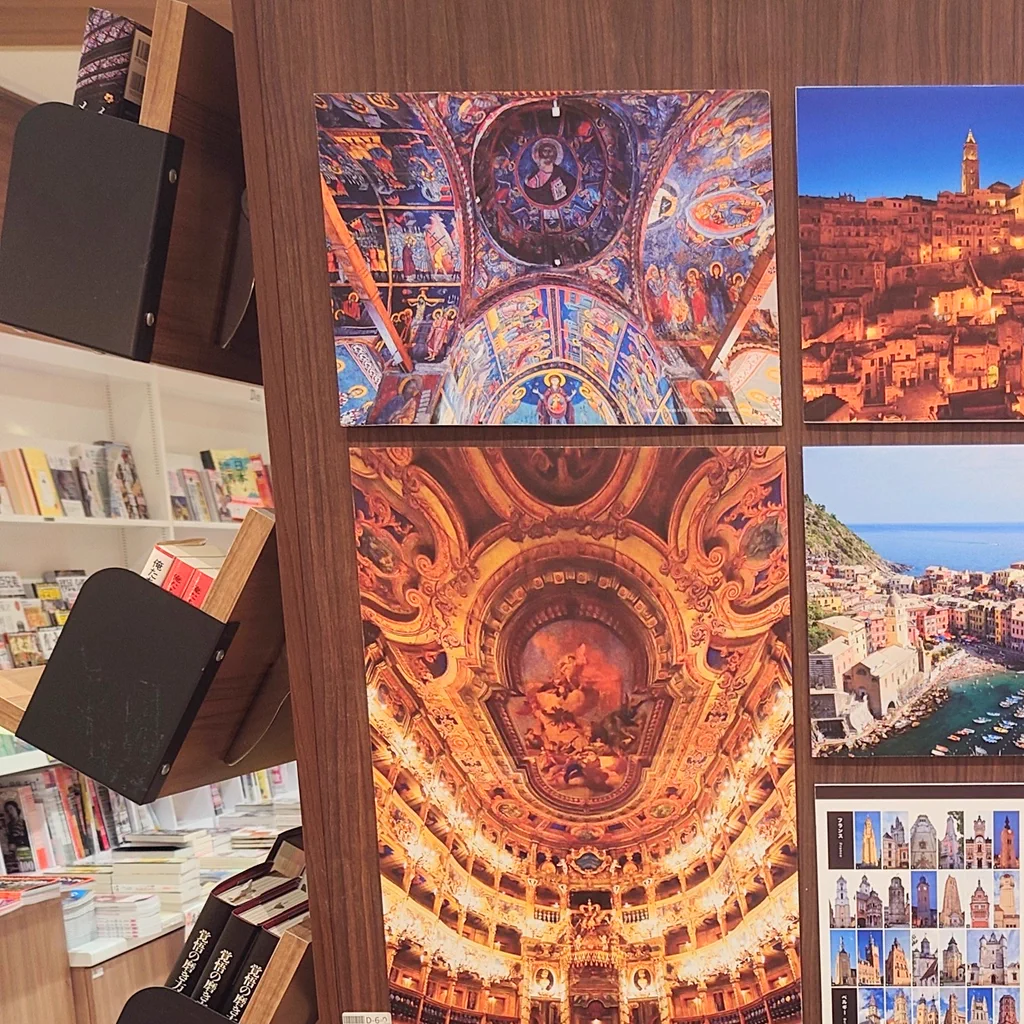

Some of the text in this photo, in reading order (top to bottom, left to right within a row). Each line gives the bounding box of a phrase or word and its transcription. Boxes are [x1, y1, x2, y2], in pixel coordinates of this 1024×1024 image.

[171, 929, 211, 992] 覚悟の磨き方
